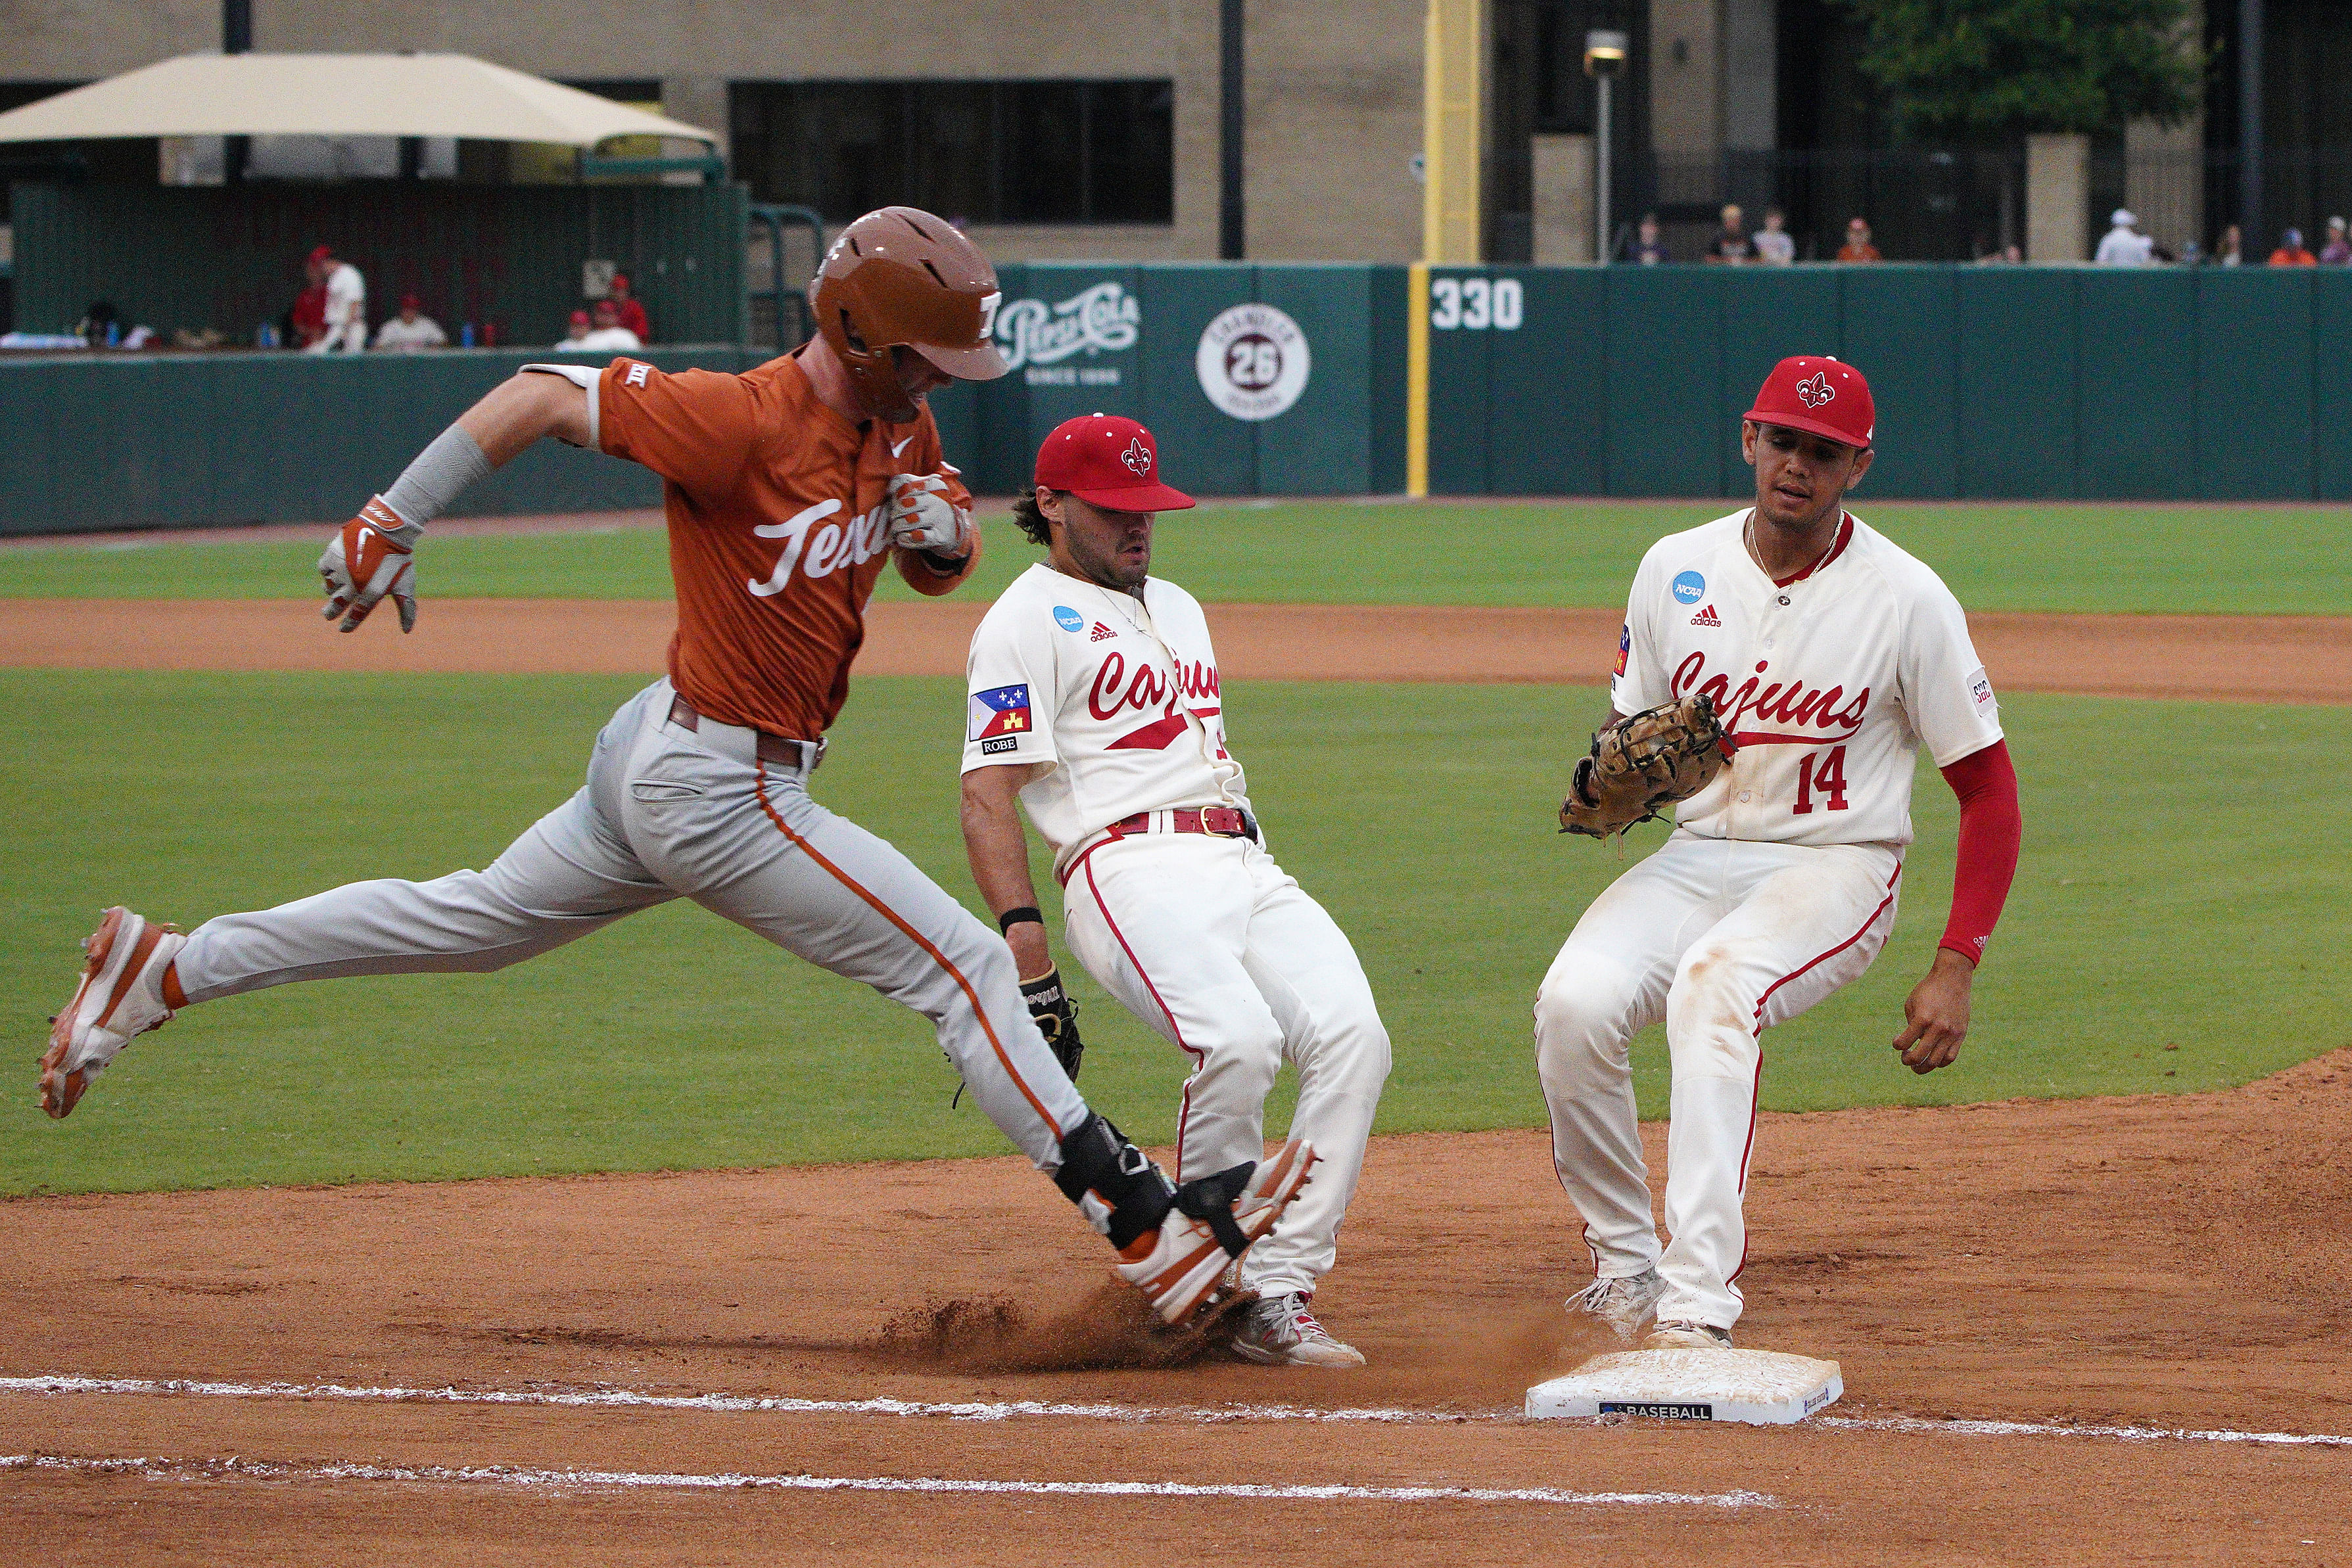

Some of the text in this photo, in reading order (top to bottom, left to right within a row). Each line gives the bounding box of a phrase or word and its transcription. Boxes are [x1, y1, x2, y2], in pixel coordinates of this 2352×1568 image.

[1432, 279, 1524, 328] 330
[1231, 342, 1278, 384] 26
[747, 498, 889, 596] Tex
[1676, 584, 1702, 597] NCAA
[1091, 631, 1117, 642] adidas
[1691, 617, 1722, 628] adidas
[1089, 652, 1220, 721] Cajun
[1670, 651, 1870, 737] Cajuns
[983, 739, 1016, 753] ROBE
[1793, 745, 1849, 815] 14
[1025, 985, 1060, 1005] Wilso
[1626, 1406, 1709, 1419] BASEBALL
